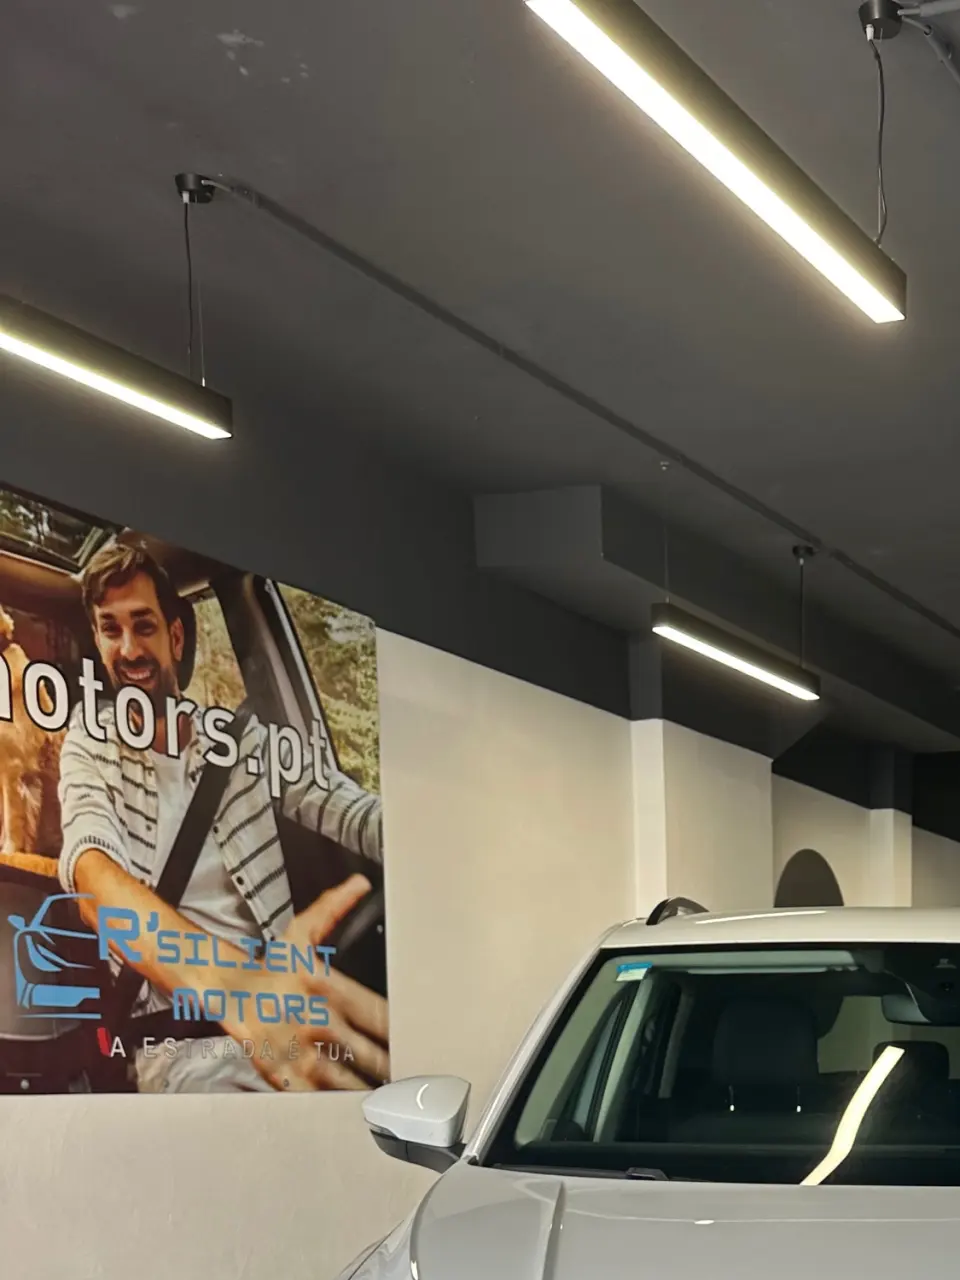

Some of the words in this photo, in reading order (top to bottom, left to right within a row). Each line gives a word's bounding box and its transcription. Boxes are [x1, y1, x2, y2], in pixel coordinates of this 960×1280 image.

[0, 653, 331, 799] otors.pt
[97, 905, 337, 977] R'SILIENT
[173, 987, 330, 1026] MOTORS
[110, 1036, 126, 1058] A
[143, 1037, 275, 1061] ESTRADA
[288, 1035, 298, 1060] É
[315, 1041, 355, 1062] TUA
